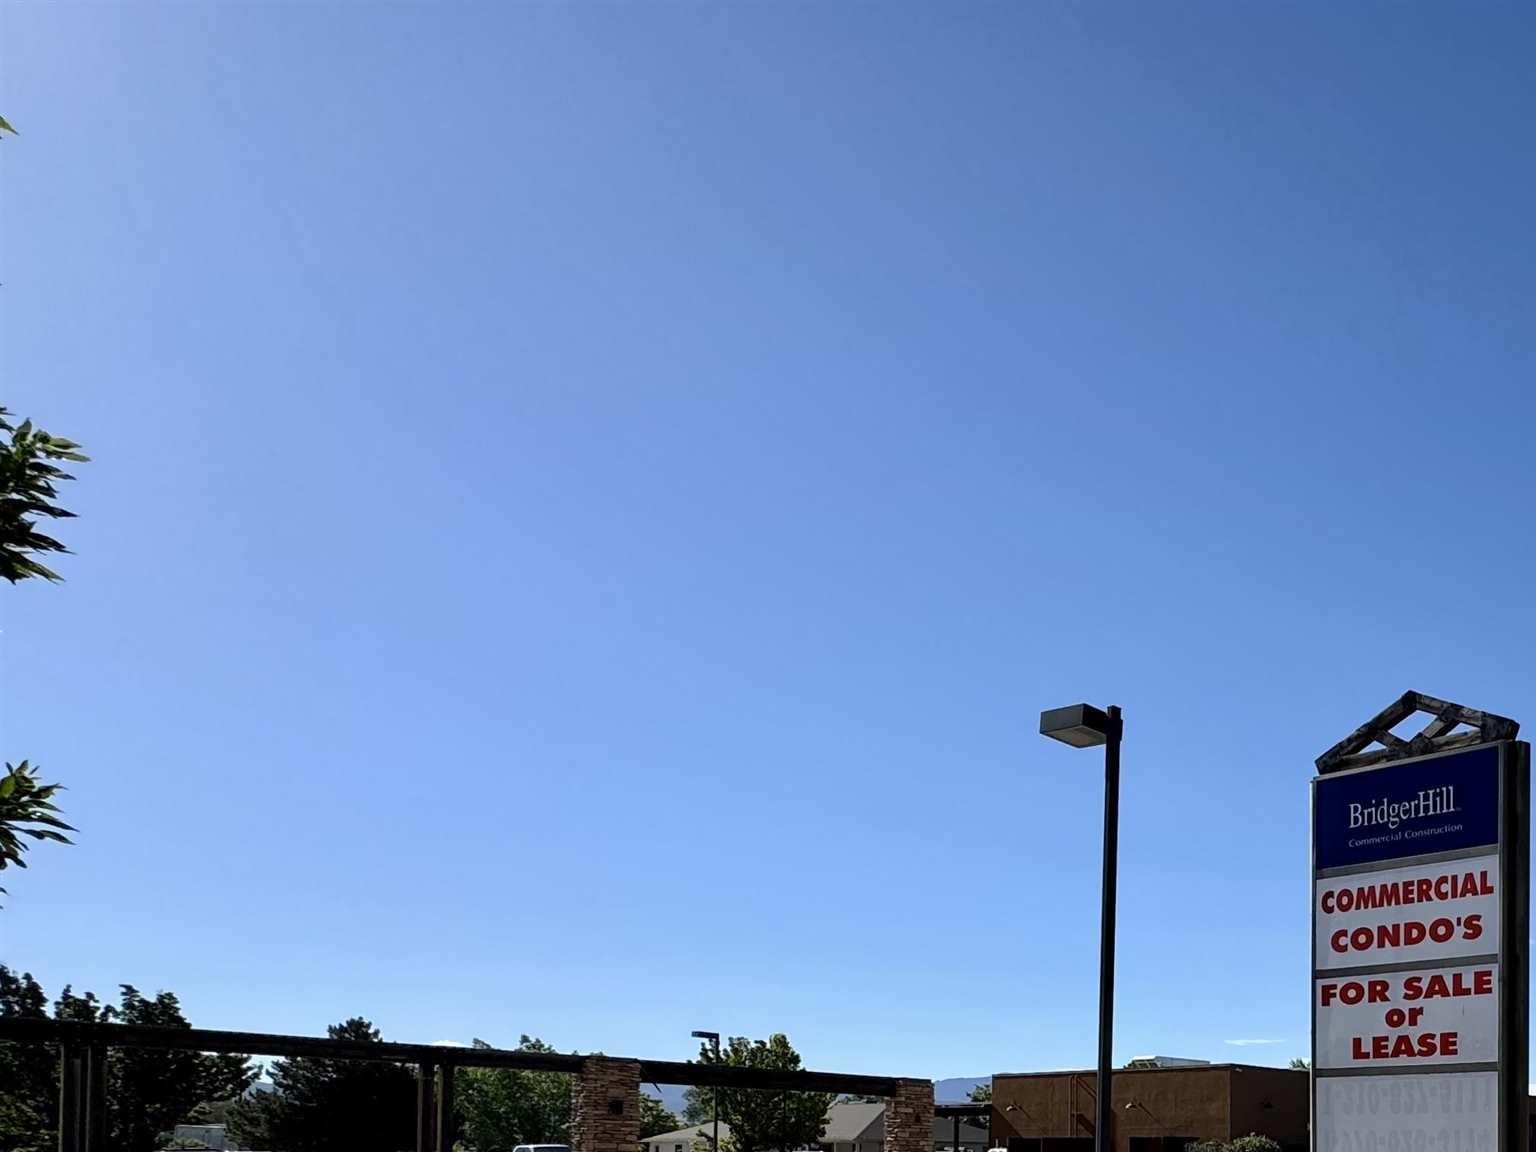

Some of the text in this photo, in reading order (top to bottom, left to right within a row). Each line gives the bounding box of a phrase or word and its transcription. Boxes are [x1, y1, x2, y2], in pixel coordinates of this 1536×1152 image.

[1349, 785, 1455, 829] BridgerHill
[1348, 823, 1463, 848] Commercial Construction
[1321, 870, 1494, 914] COMMERCIAL
[1330, 914, 1483, 953] CONDO'S
[1321, 970, 1493, 1007] FOR SALE
[1385, 1006, 1424, 1028] or
[1352, 1032, 1458, 1060] LEASE
